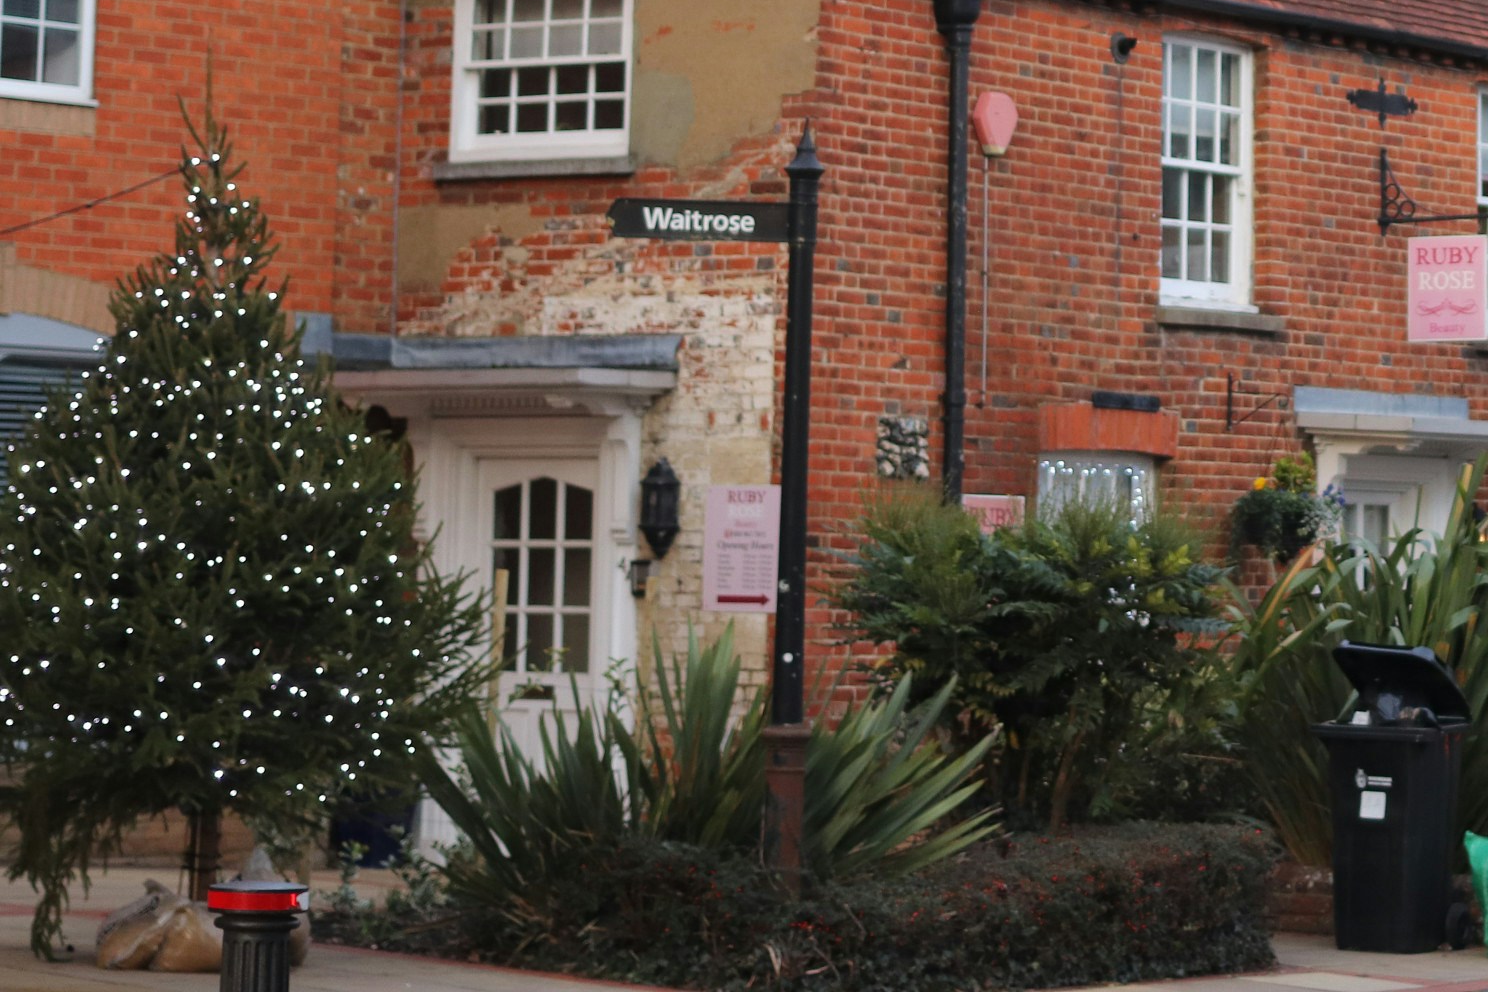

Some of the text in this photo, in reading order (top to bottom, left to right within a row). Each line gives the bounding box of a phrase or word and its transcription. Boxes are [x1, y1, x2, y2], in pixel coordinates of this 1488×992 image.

[642, 206, 755, 233] Waitrose
[1415, 246, 1478, 265] RUBY
[1418, 270, 1475, 290] ROSE
[727, 490, 766, 504] RUBY
